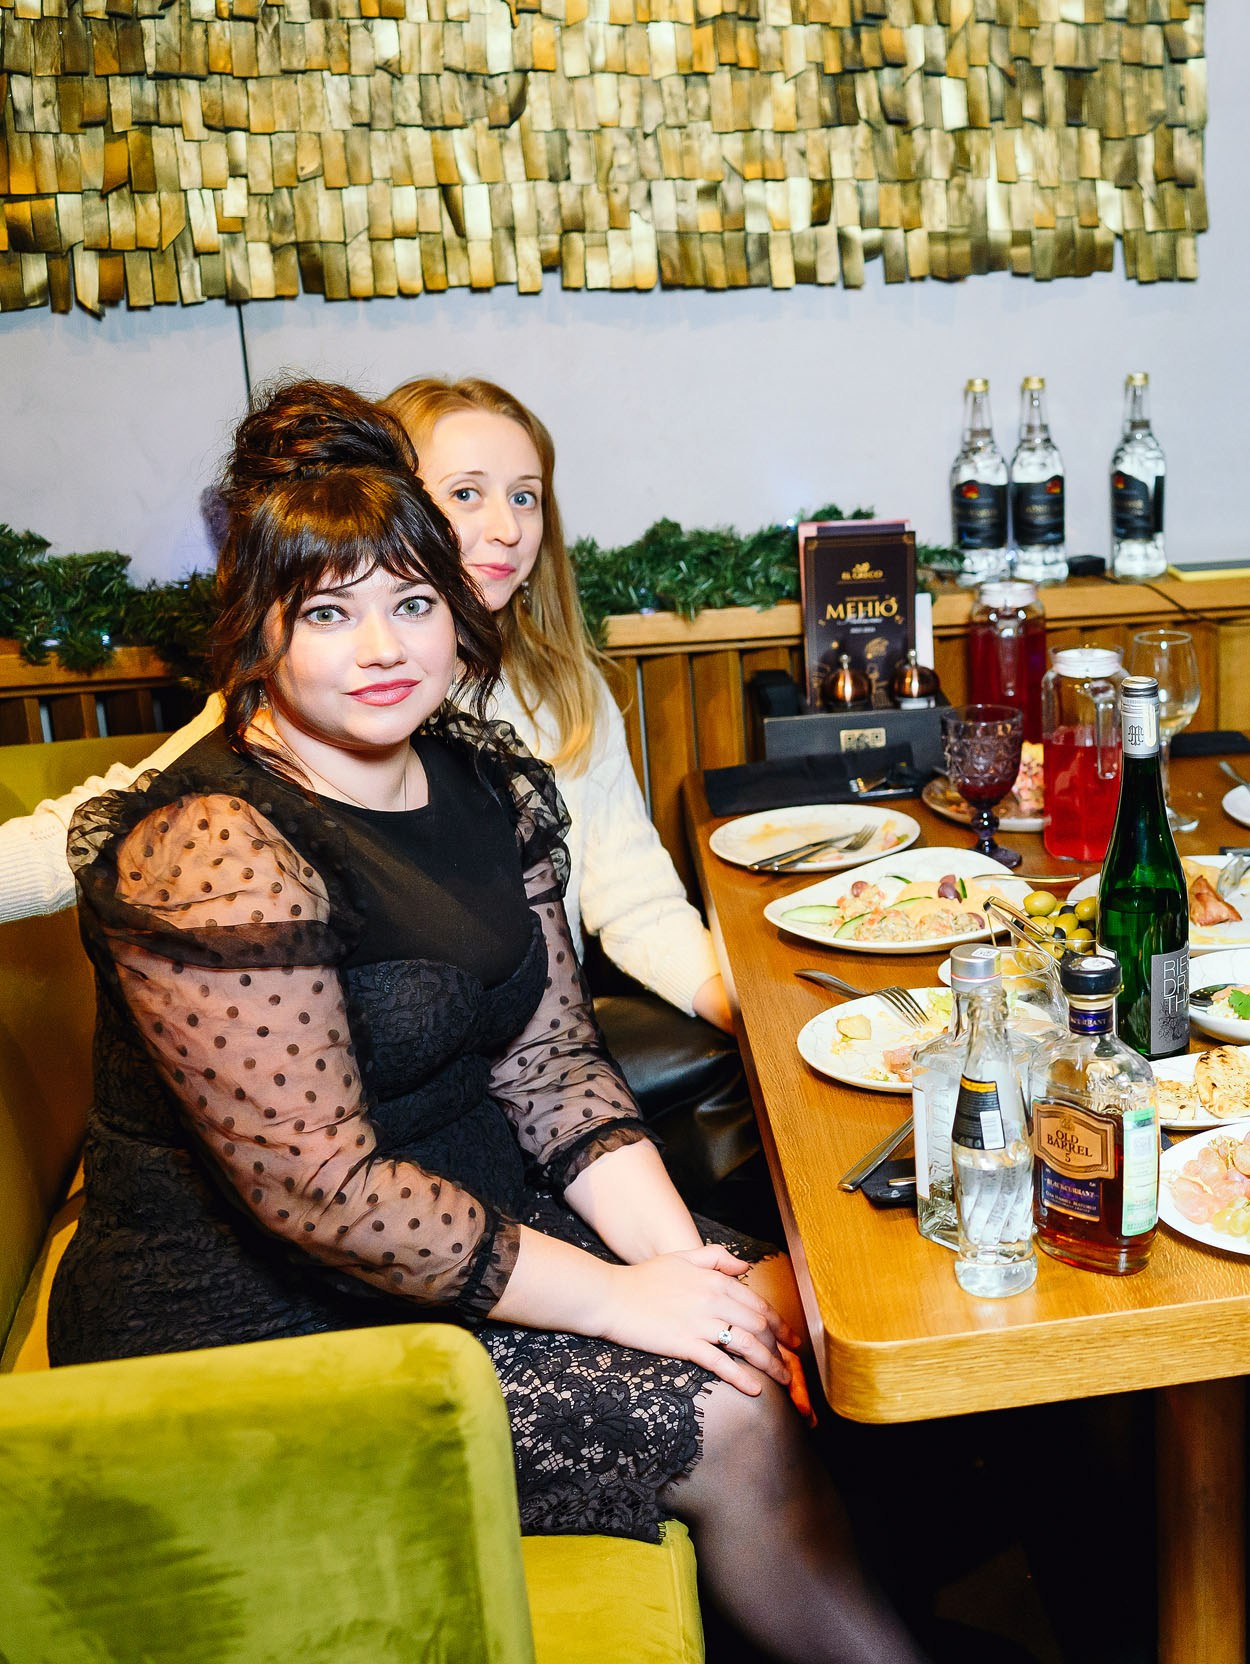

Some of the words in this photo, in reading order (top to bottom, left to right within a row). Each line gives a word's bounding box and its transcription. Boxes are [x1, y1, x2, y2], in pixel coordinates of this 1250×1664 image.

[826, 598, 898, 620] МЕНЮ
[1047, 1134, 1093, 1157] BARREL
[1055, 1130, 1079, 1144] OLD
